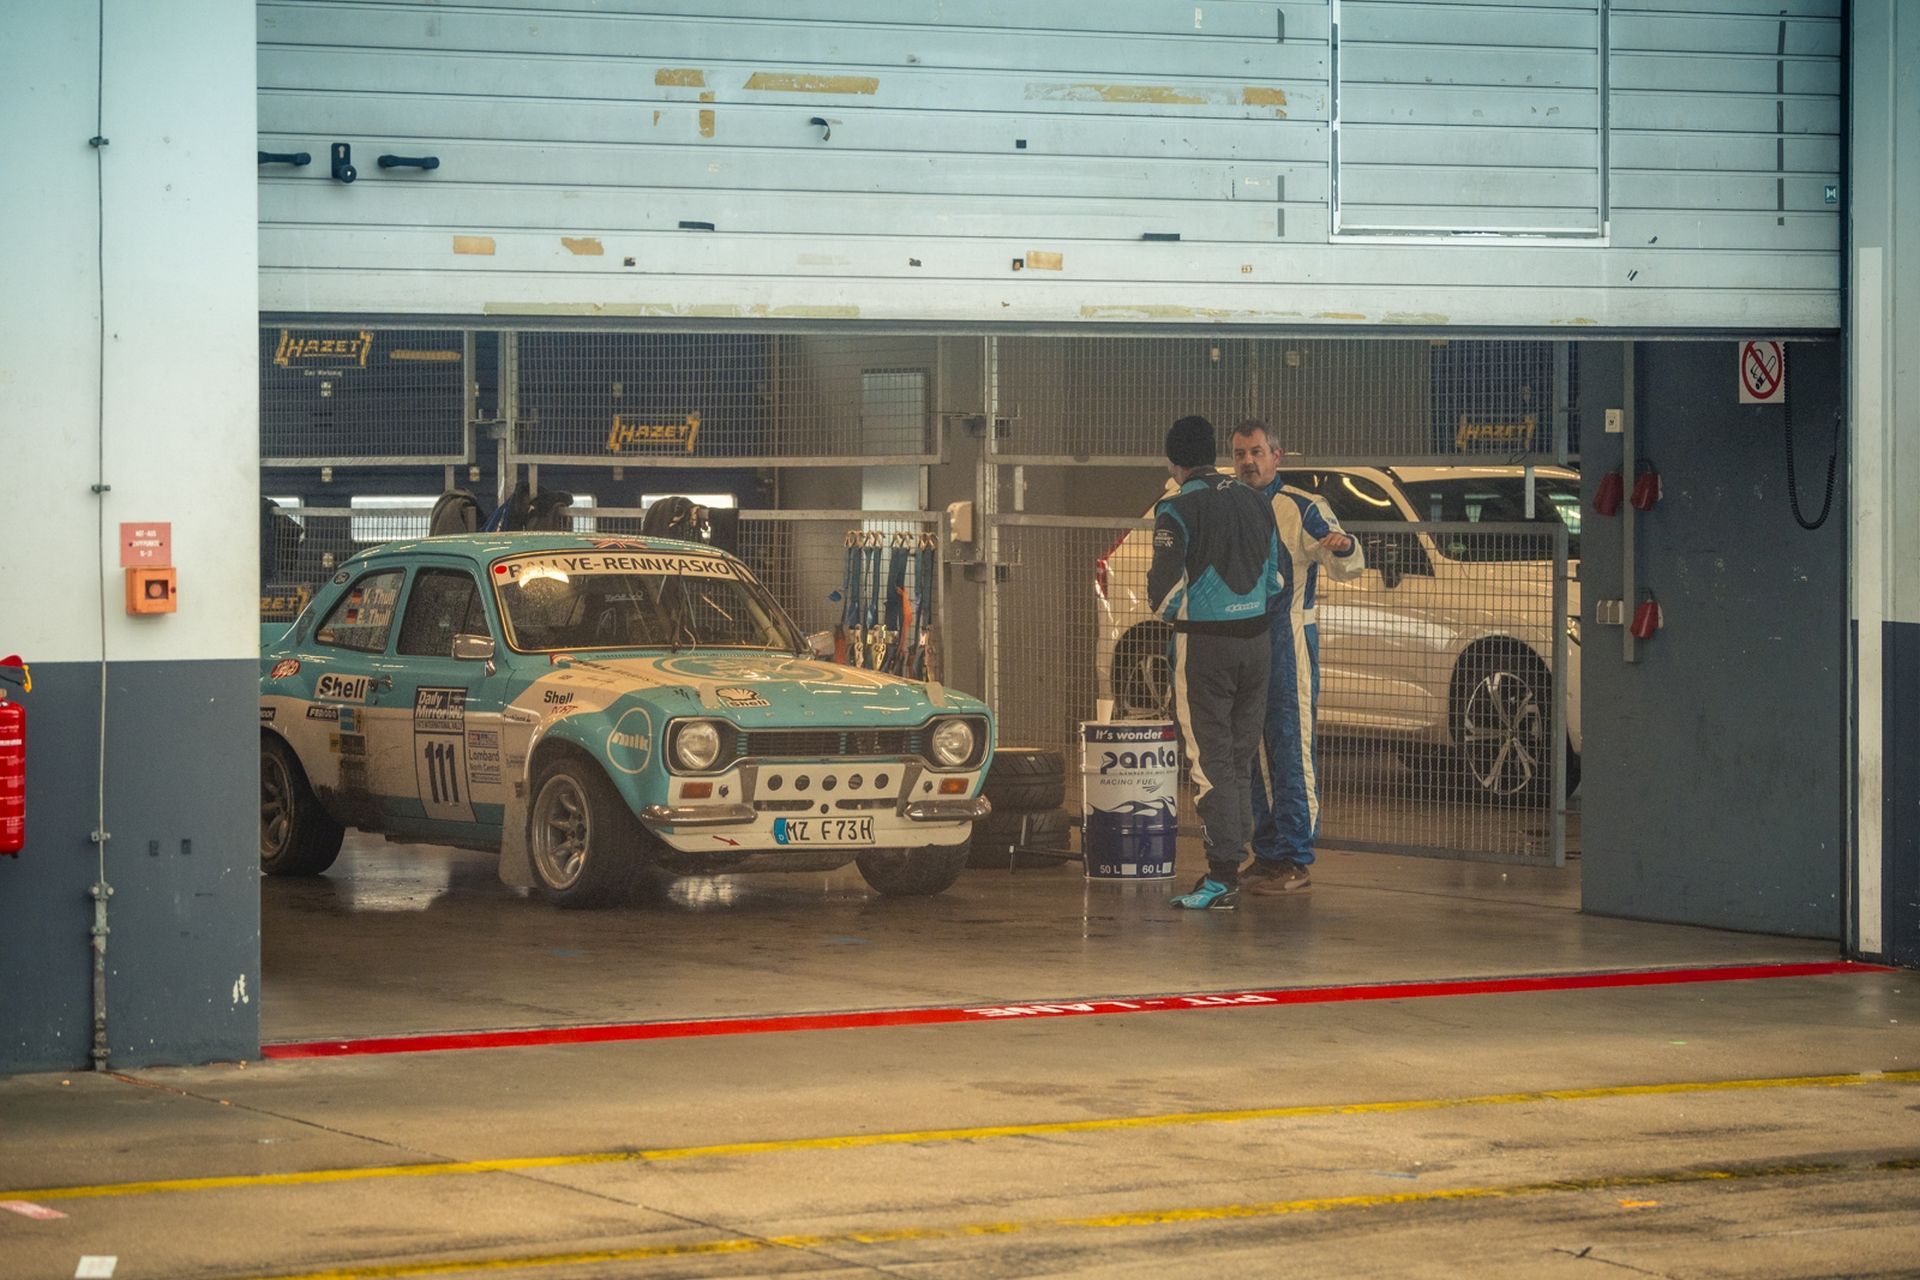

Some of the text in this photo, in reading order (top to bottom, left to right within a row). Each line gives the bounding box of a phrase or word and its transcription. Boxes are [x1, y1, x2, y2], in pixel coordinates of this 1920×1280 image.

[619, 424, 688, 443] HAZET
[319, 676, 366, 699] Shell
[419, 691, 443, 708] Daily
[543, 690, 574, 705] Shell
[415, 705, 447, 719] Mirror
[1095, 729, 1114, 740] It's
[468, 749, 500, 761] Lombard
[1101, 745, 1176, 775] panta
[424, 740, 460, 804] 111
[1100, 778, 1133, 786] RACING
[786, 822, 810, 841] MZ
[1100, 865, 1121, 874] 50 L
[1142, 864, 1163, 874] 60 L
[1181, 994, 1278, 1006] PIT
[963, 1001, 1141, 1017] LANE
